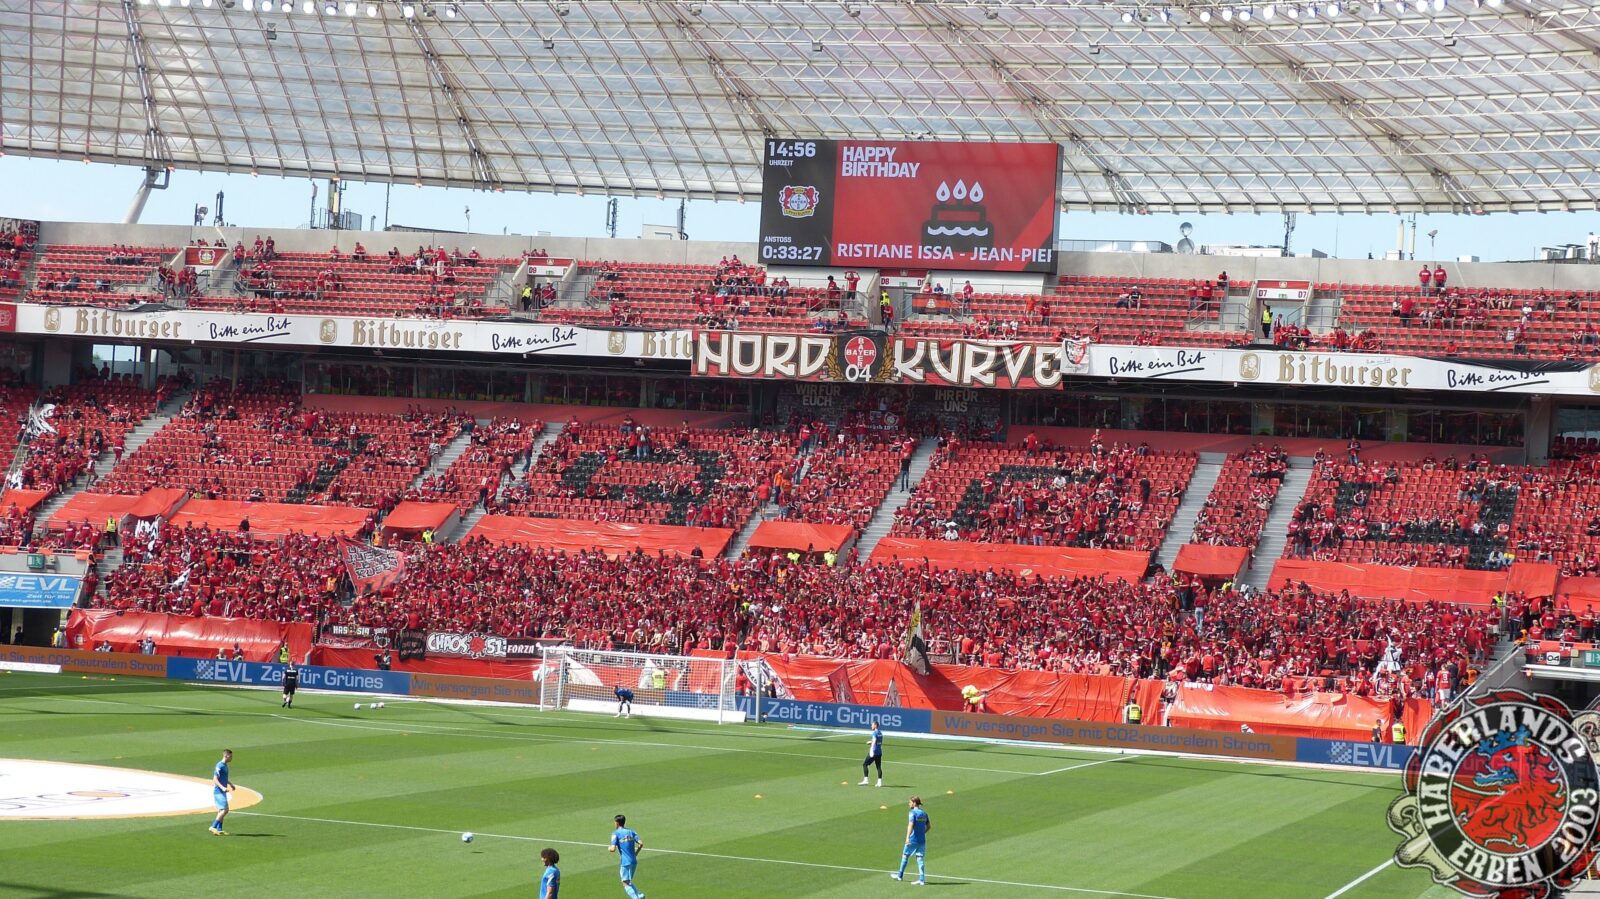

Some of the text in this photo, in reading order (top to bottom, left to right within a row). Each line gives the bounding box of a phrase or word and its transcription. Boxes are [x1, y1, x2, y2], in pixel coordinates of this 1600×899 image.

[768, 142, 816, 157] 14:56
[842, 146, 896, 162] HAPPY
[841, 162, 920, 178] BIRTHDAY
[762, 245, 822, 260] 0:33:27
[837, 243, 913, 260] RISTIANE
[917, 245, 954, 260] ISSA
[75, 308, 182, 339] Bitburger
[209, 316, 291, 340] Bitte ein Bit
[351, 318, 464, 350] Bitburger
[491, 326, 578, 352] Bitte ein Bit
[697, 332, 1064, 387] NORD KURVE
[846, 348, 875, 356] BAYER
[845, 363, 872, 382] 04
[1109, 356, 1144, 375] Bitte
[1147, 359, 1174, 370] ein
[1177, 350, 1206, 367] Bit
[1276, 354, 1412, 387] Bitburger
[1447, 369, 1484, 388] Bitte
[1488, 372, 1517, 383] ein
[796, 384, 817, 396] WIR
[935, 389, 954, 401] IHR
[802, 396, 832, 406] EUCH
[15, 576, 75, 592] EVL
[427, 632, 469, 653] CHAOS
[507, 645, 535, 654] FORZA
[10, 651, 25, 663] Sie
[28, 653, 44, 663] mit
[47, 654, 128, 670] CO2-neutralem
[130, 659, 166, 673] Strom.
[214, 660, 253, 683] EVL
[324, 669, 384, 690] Grünes
[435, 683, 491, 698] versorgen
[494, 684, 512, 697] Sie
[767, 701, 902, 728] Zeit für Grünes
[944, 716, 1274, 753] Wir versorgen Sie mit CO2-neutralem Strom.
[1353, 742, 1400, 768] EVL
